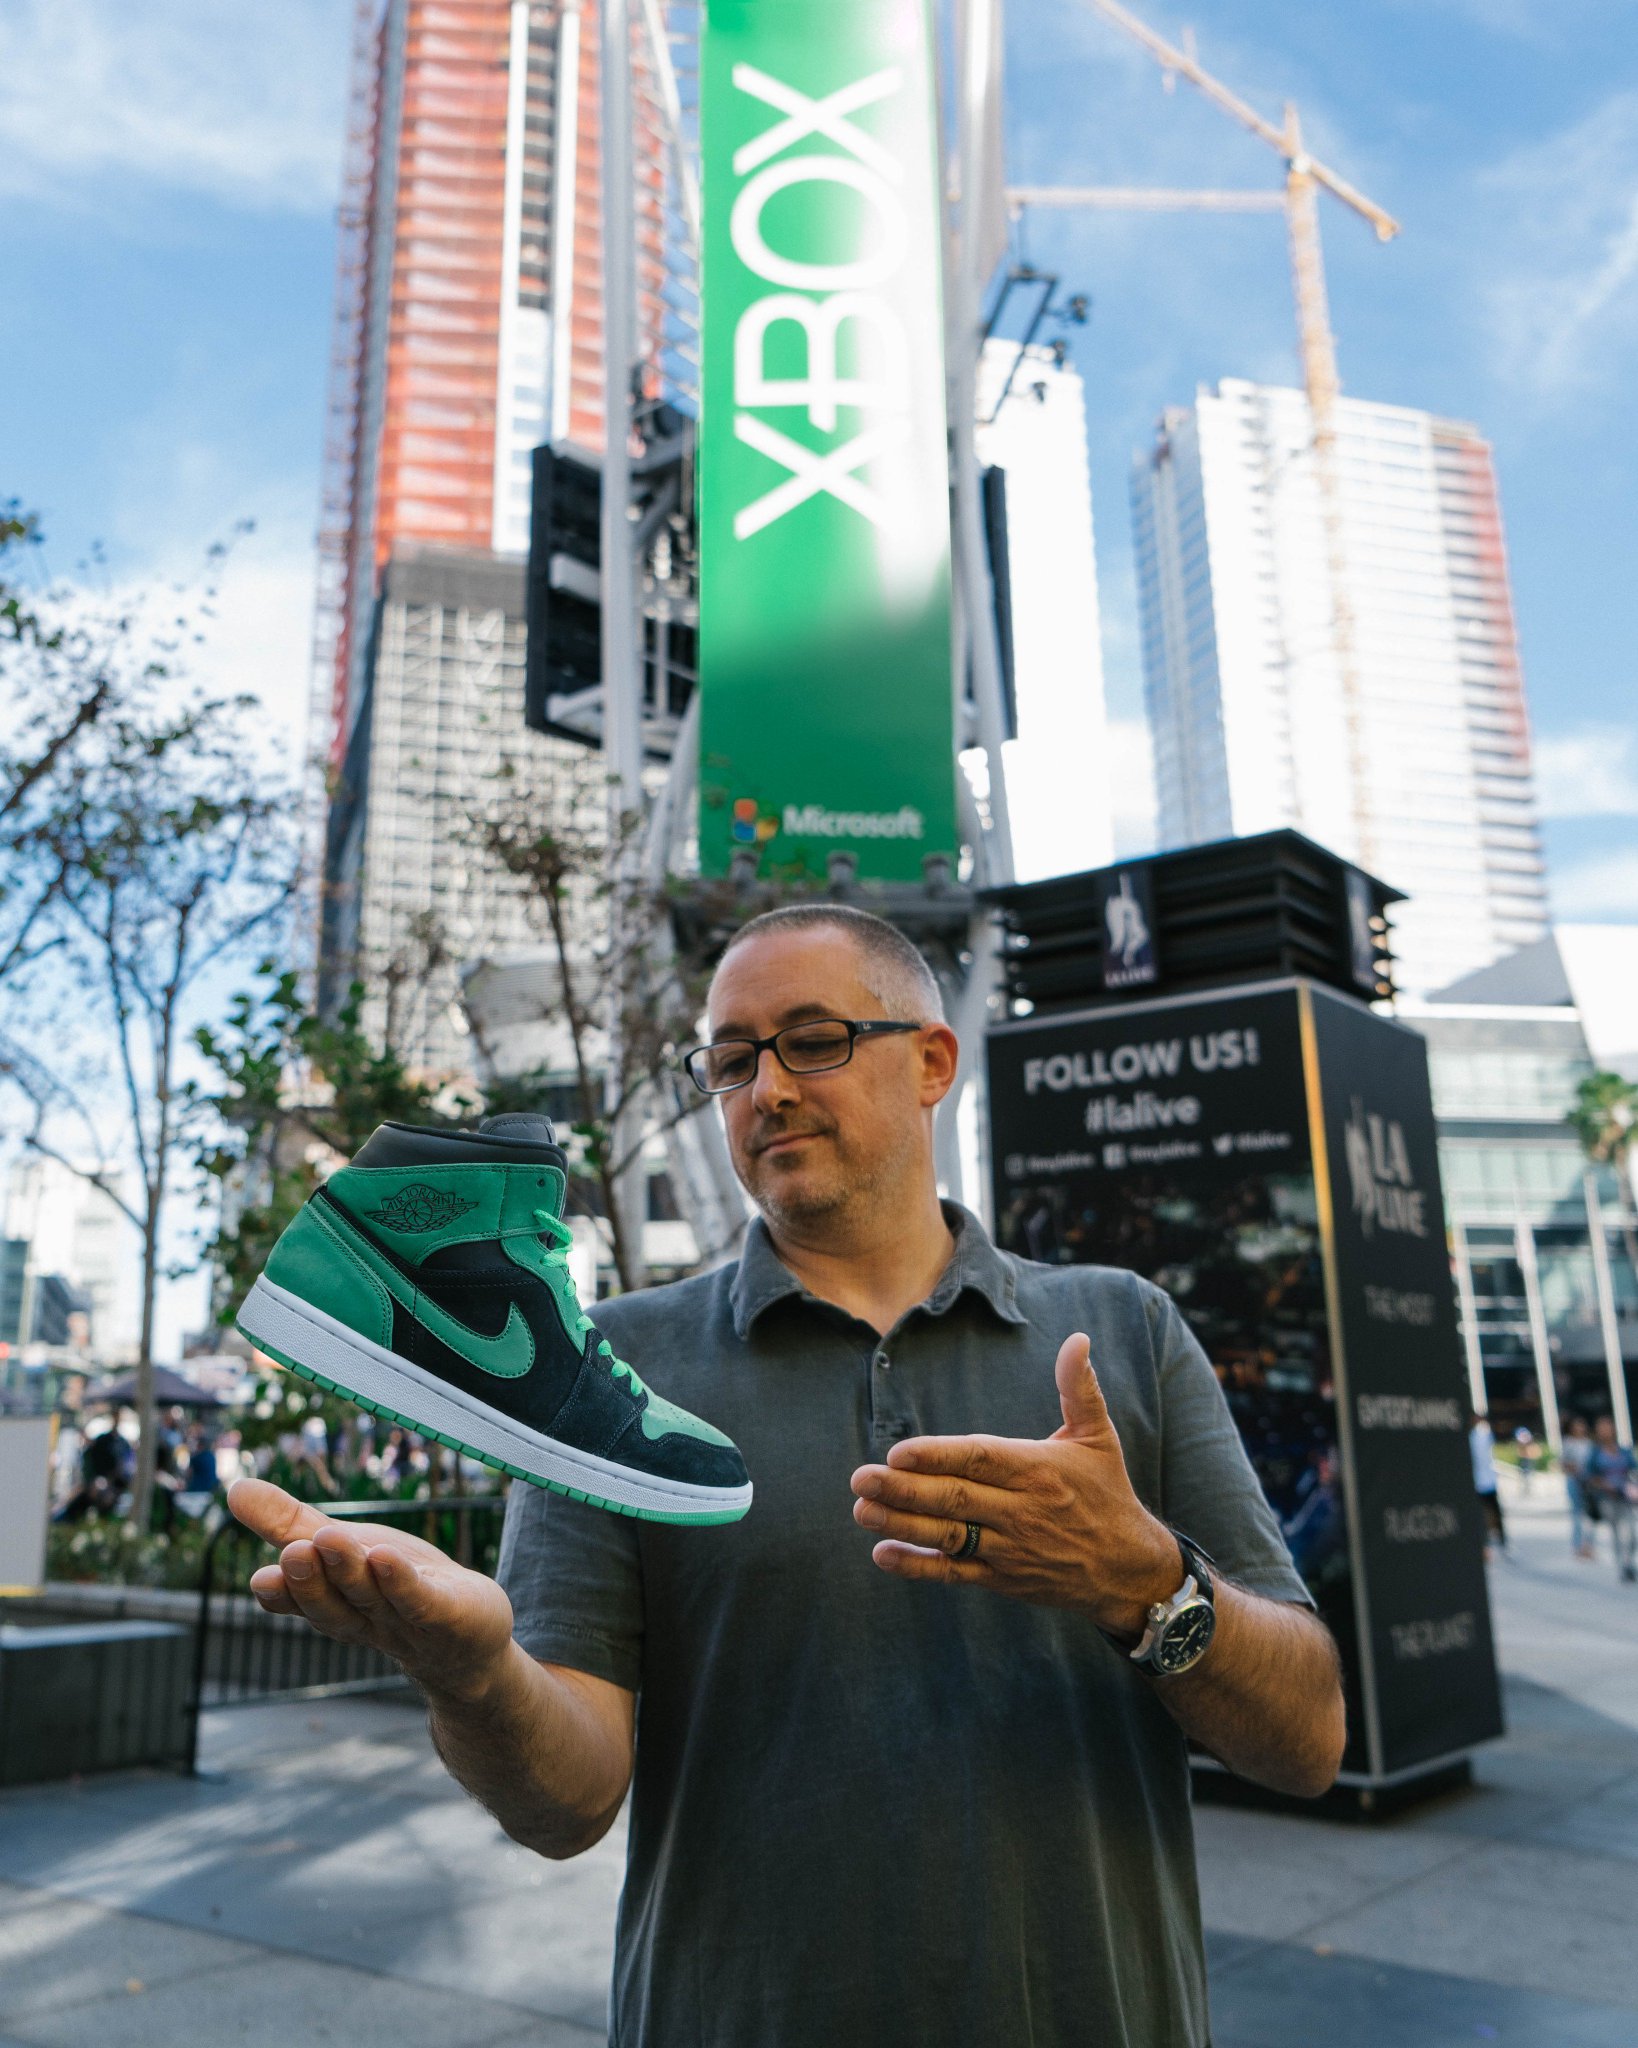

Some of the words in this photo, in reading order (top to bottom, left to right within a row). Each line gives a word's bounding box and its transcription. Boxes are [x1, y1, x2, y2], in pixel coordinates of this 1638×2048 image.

[729, 61, 913, 542] XBOX
[783, 803, 924, 840] Microsoft
[1024, 1037, 1182, 1094] FOLLOW
[1189, 1027, 1259, 1072] US!
[1084, 1090, 1201, 1134] #lalive
[1367, 1113, 1413, 1188] LA
[386, 1196, 406, 1212] AIR
[405, 1187, 453, 1208] JORDAN
